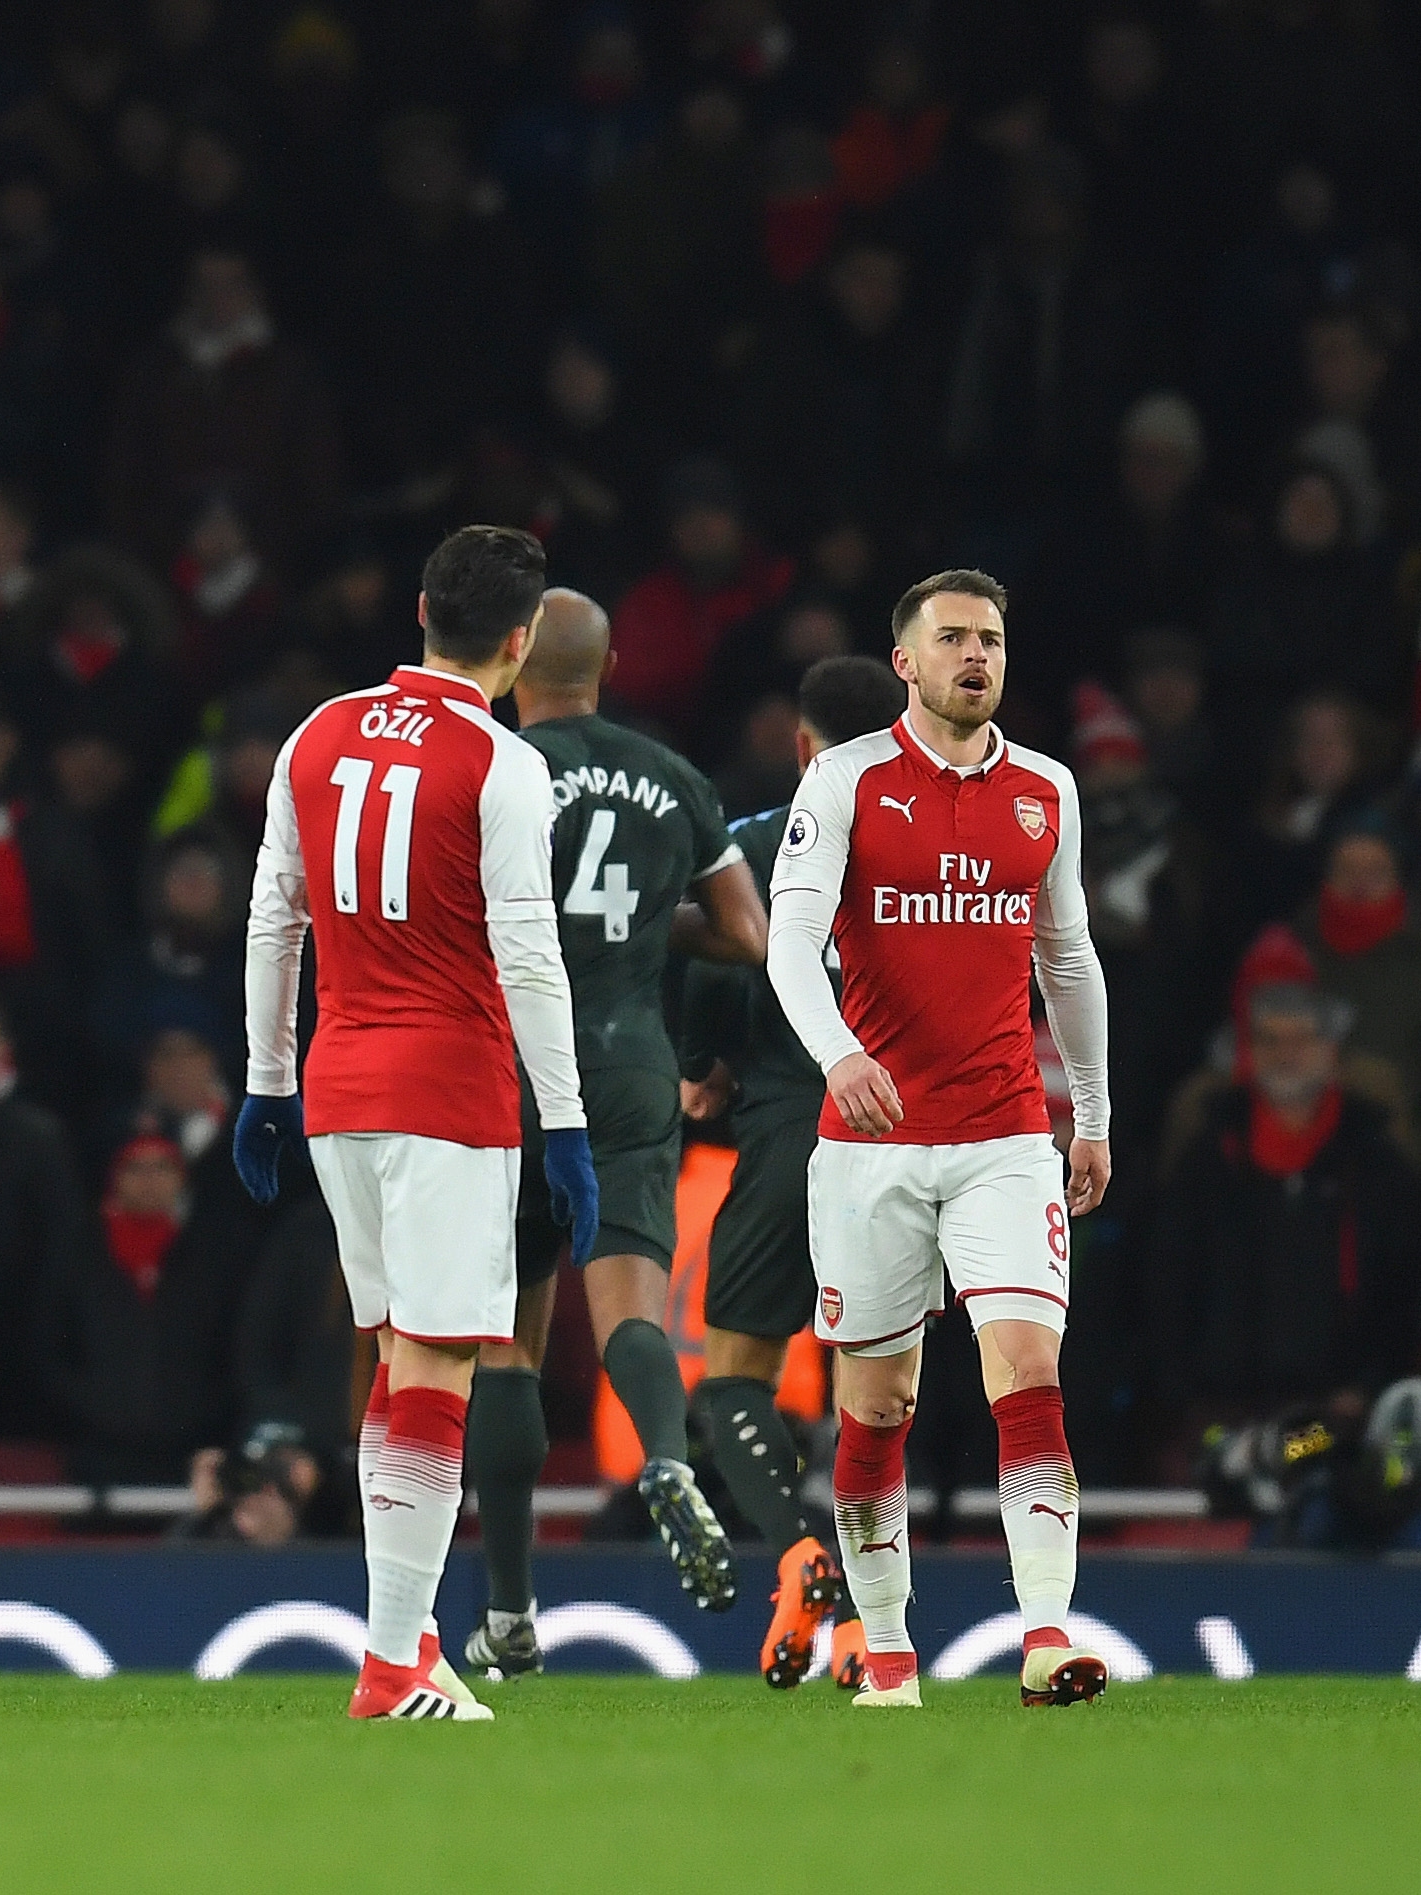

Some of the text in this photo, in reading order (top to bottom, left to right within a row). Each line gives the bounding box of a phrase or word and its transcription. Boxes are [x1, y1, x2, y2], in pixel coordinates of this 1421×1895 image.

[360, 702, 434, 747] ÖZIL
[550, 765, 678, 818] OMPANY
[329, 756, 422, 921] 11
[563, 809, 640, 942] 4
[939, 853, 991, 887] Fly
[872, 882, 1031, 925] Emirates
[1045, 1202, 1067, 1262] 8
